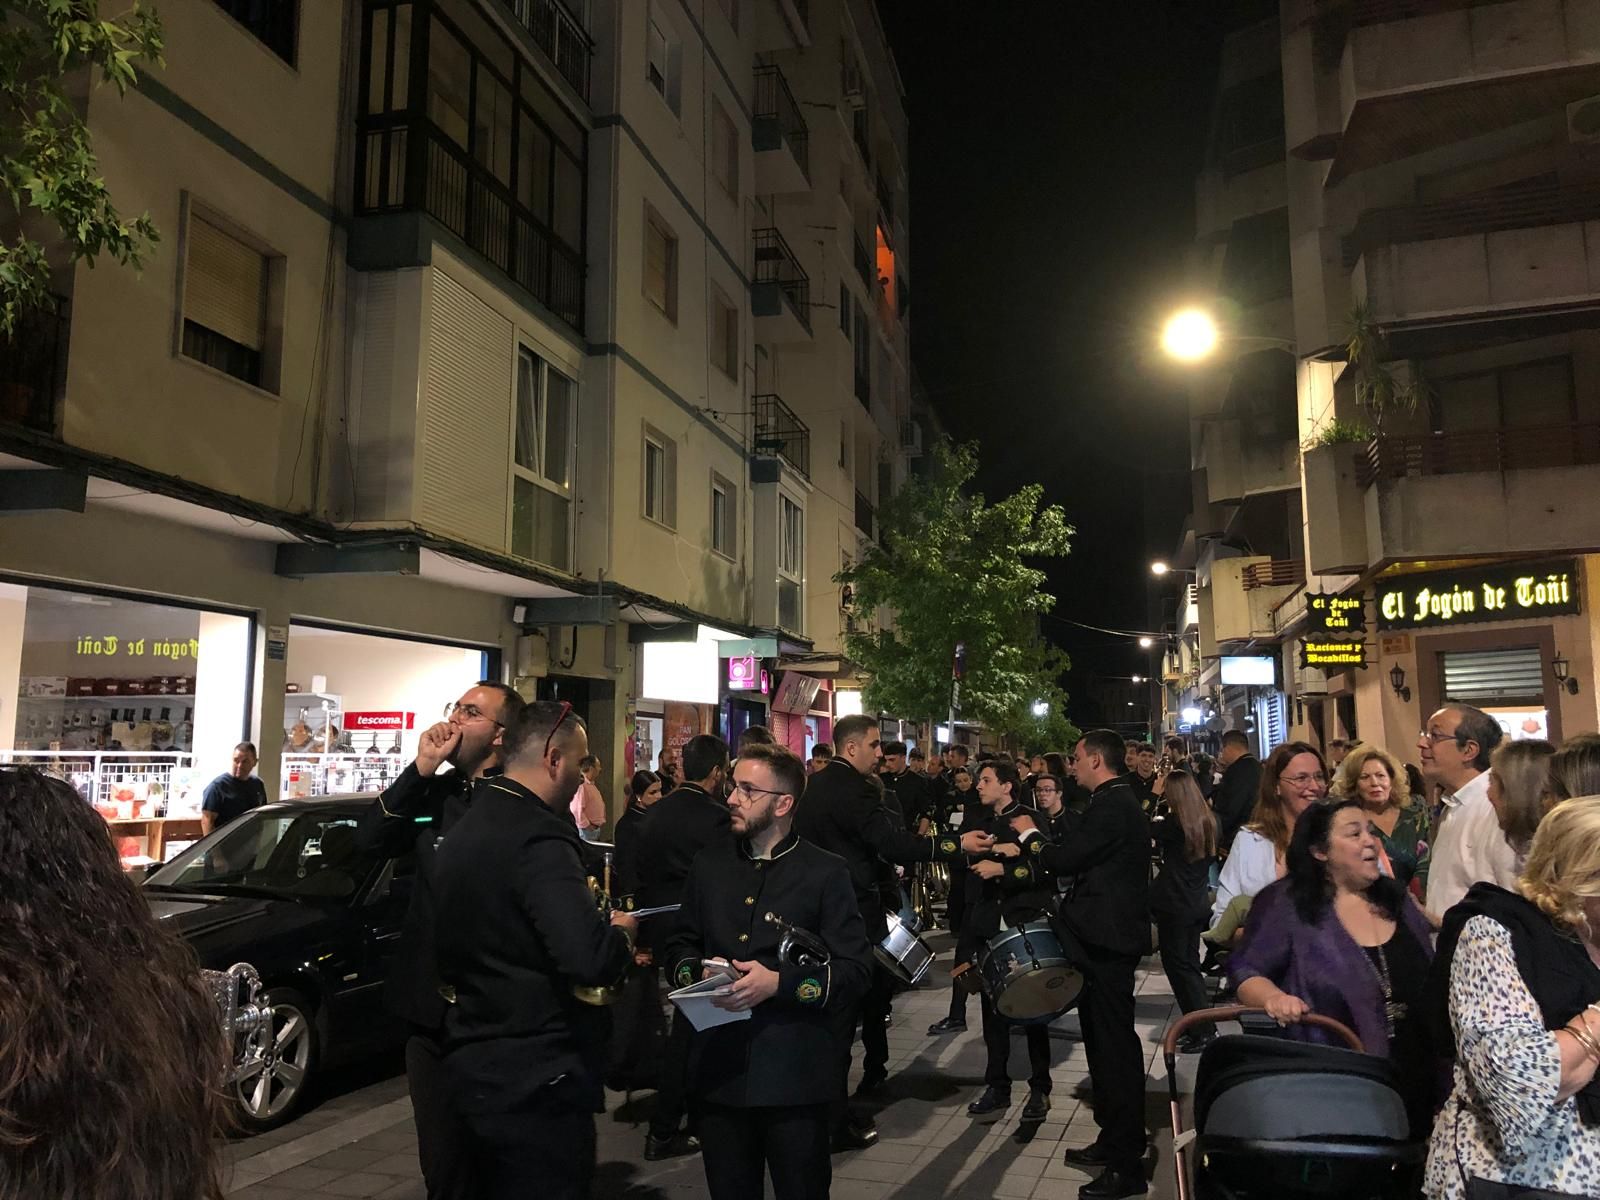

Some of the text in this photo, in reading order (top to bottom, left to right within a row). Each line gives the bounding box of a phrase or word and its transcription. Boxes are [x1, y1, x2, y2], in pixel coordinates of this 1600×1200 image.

[1382, 591, 1405, 620] El
[1483, 582, 1506, 610] de
[1515, 574, 1569, 607] Toñi
[1312, 598, 1325, 609] El
[1306, 643, 1353, 652] Raciones
